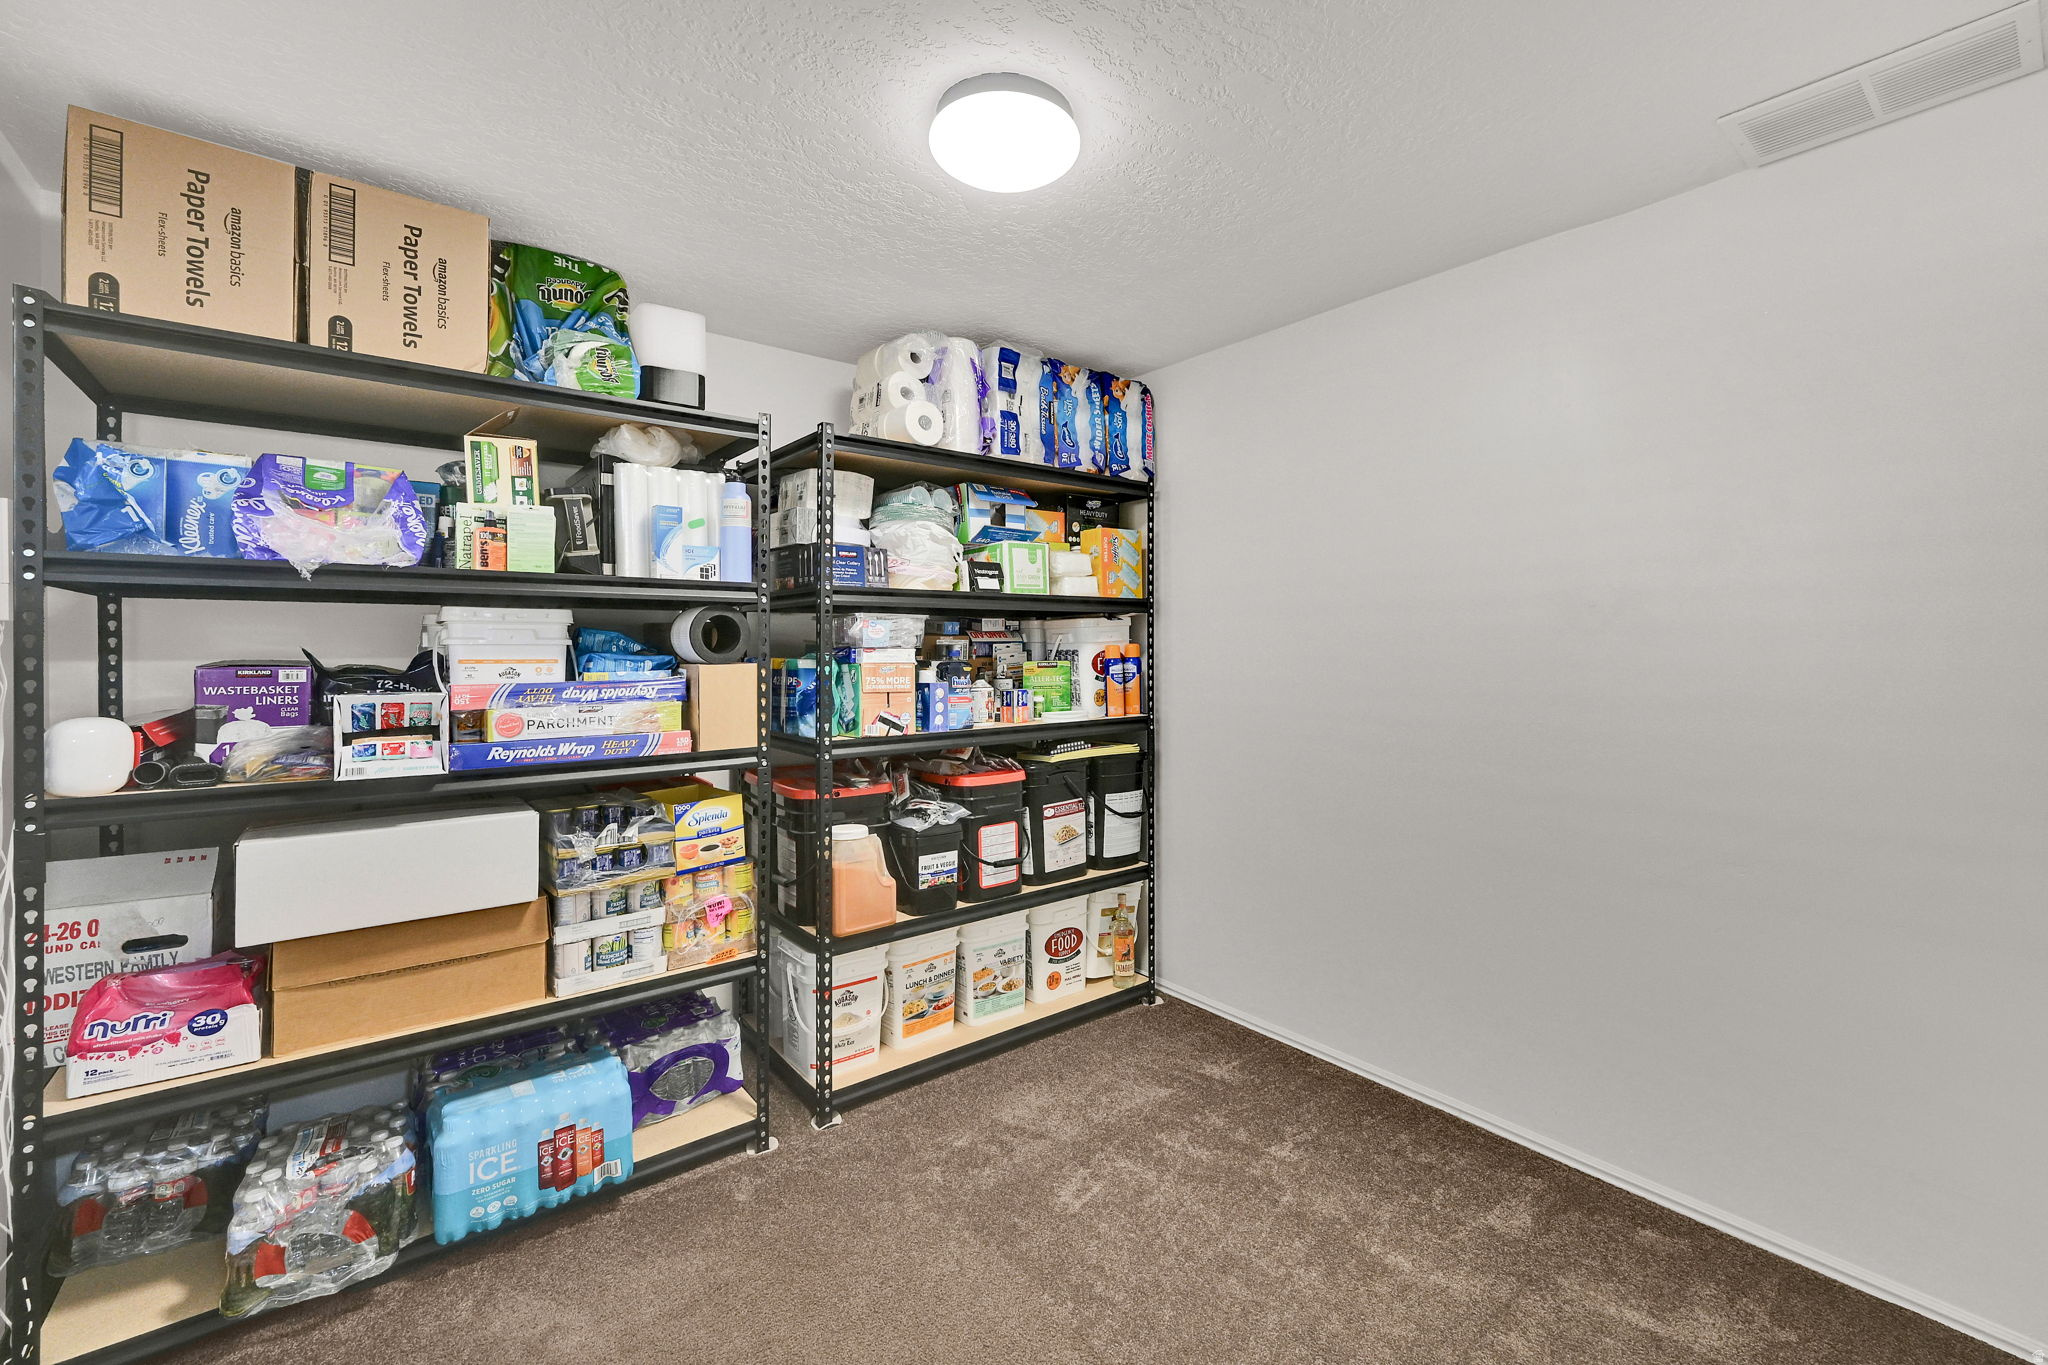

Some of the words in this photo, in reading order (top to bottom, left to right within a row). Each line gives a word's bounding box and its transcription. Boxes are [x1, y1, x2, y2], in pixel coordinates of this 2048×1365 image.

[179, 168, 211, 232] Paper
[157, 211, 169, 257] Flex-sheets
[230, 207, 243, 249] amazon
[398, 225, 422, 280] Paper
[185, 236, 211, 308] Towels
[230, 248, 246, 288] basics
[554, 255, 581, 274] THE
[381, 261, 392, 302] Flex-sheets
[438, 257, 447, 295] amazon
[546, 277, 586, 290] Advanced
[402, 284, 423, 349] Towels
[437, 294, 450, 330] basics
[336, 341, 348, 351] 12
[1040, 386, 1049, 410] Bath
[1009, 420, 1017, 431] 30
[1040, 410, 1049, 435] Tissue
[1093, 417, 1102, 449] WIDER
[1145, 433, 1153, 460] MORE
[1062, 452, 1069, 463] 30
[208, 511, 216, 525] care
[1080, 509, 1096, 517] HEAVY
[178, 495, 208, 555] Kleenex
[575, 506, 584, 540] FoodSaver
[208, 526, 216, 545] trusted
[459, 515, 473, 570] Natrapel
[479, 540, 489, 568] Ben's
[203, 685, 300, 696] WASTEBASKET
[523, 686, 554, 695] DUTY
[865, 676, 886, 686] 75%
[886, 676, 911, 686] MORE
[255, 695, 299, 706] LINERS
[454, 698, 470, 706] 150
[519, 693, 556, 704] HEAVY
[562, 687, 598, 701] Wrap
[599, 686, 659, 700] Reynolds
[526, 715, 615, 731] PARCHMENT
[487, 745, 557, 763] Reynolds
[558, 742, 595, 759] Wrap
[601, 739, 640, 750] HEAVY
[603, 747, 633, 757] DUTY
[687, 809, 728, 828] Splenda
[921, 863, 935, 872] FRUIT
[1051, 934, 1078, 953] FOOD
[999, 954, 1024, 967] VARIETY
[44, 959, 114, 986] WESTERN
[905, 979, 928, 990] LUNCH
[933, 968, 955, 982] DINNER
[44, 1022, 69, 1032] LEASE
[86, 1010, 171, 1040] nurri
[192, 1014, 226, 1027] 30g
[193, 1024, 219, 1032] protein
[98, 1068, 114, 1076] pack
[468, 1138, 518, 1161] SPARKLING
[539, 1146, 554, 1156] ICE
[556, 1134, 576, 1149] ICE
[468, 1149, 519, 1184] ICE
[471, 1185, 491, 1196] ZERO
[491, 1176, 516, 1190] SUGAR
